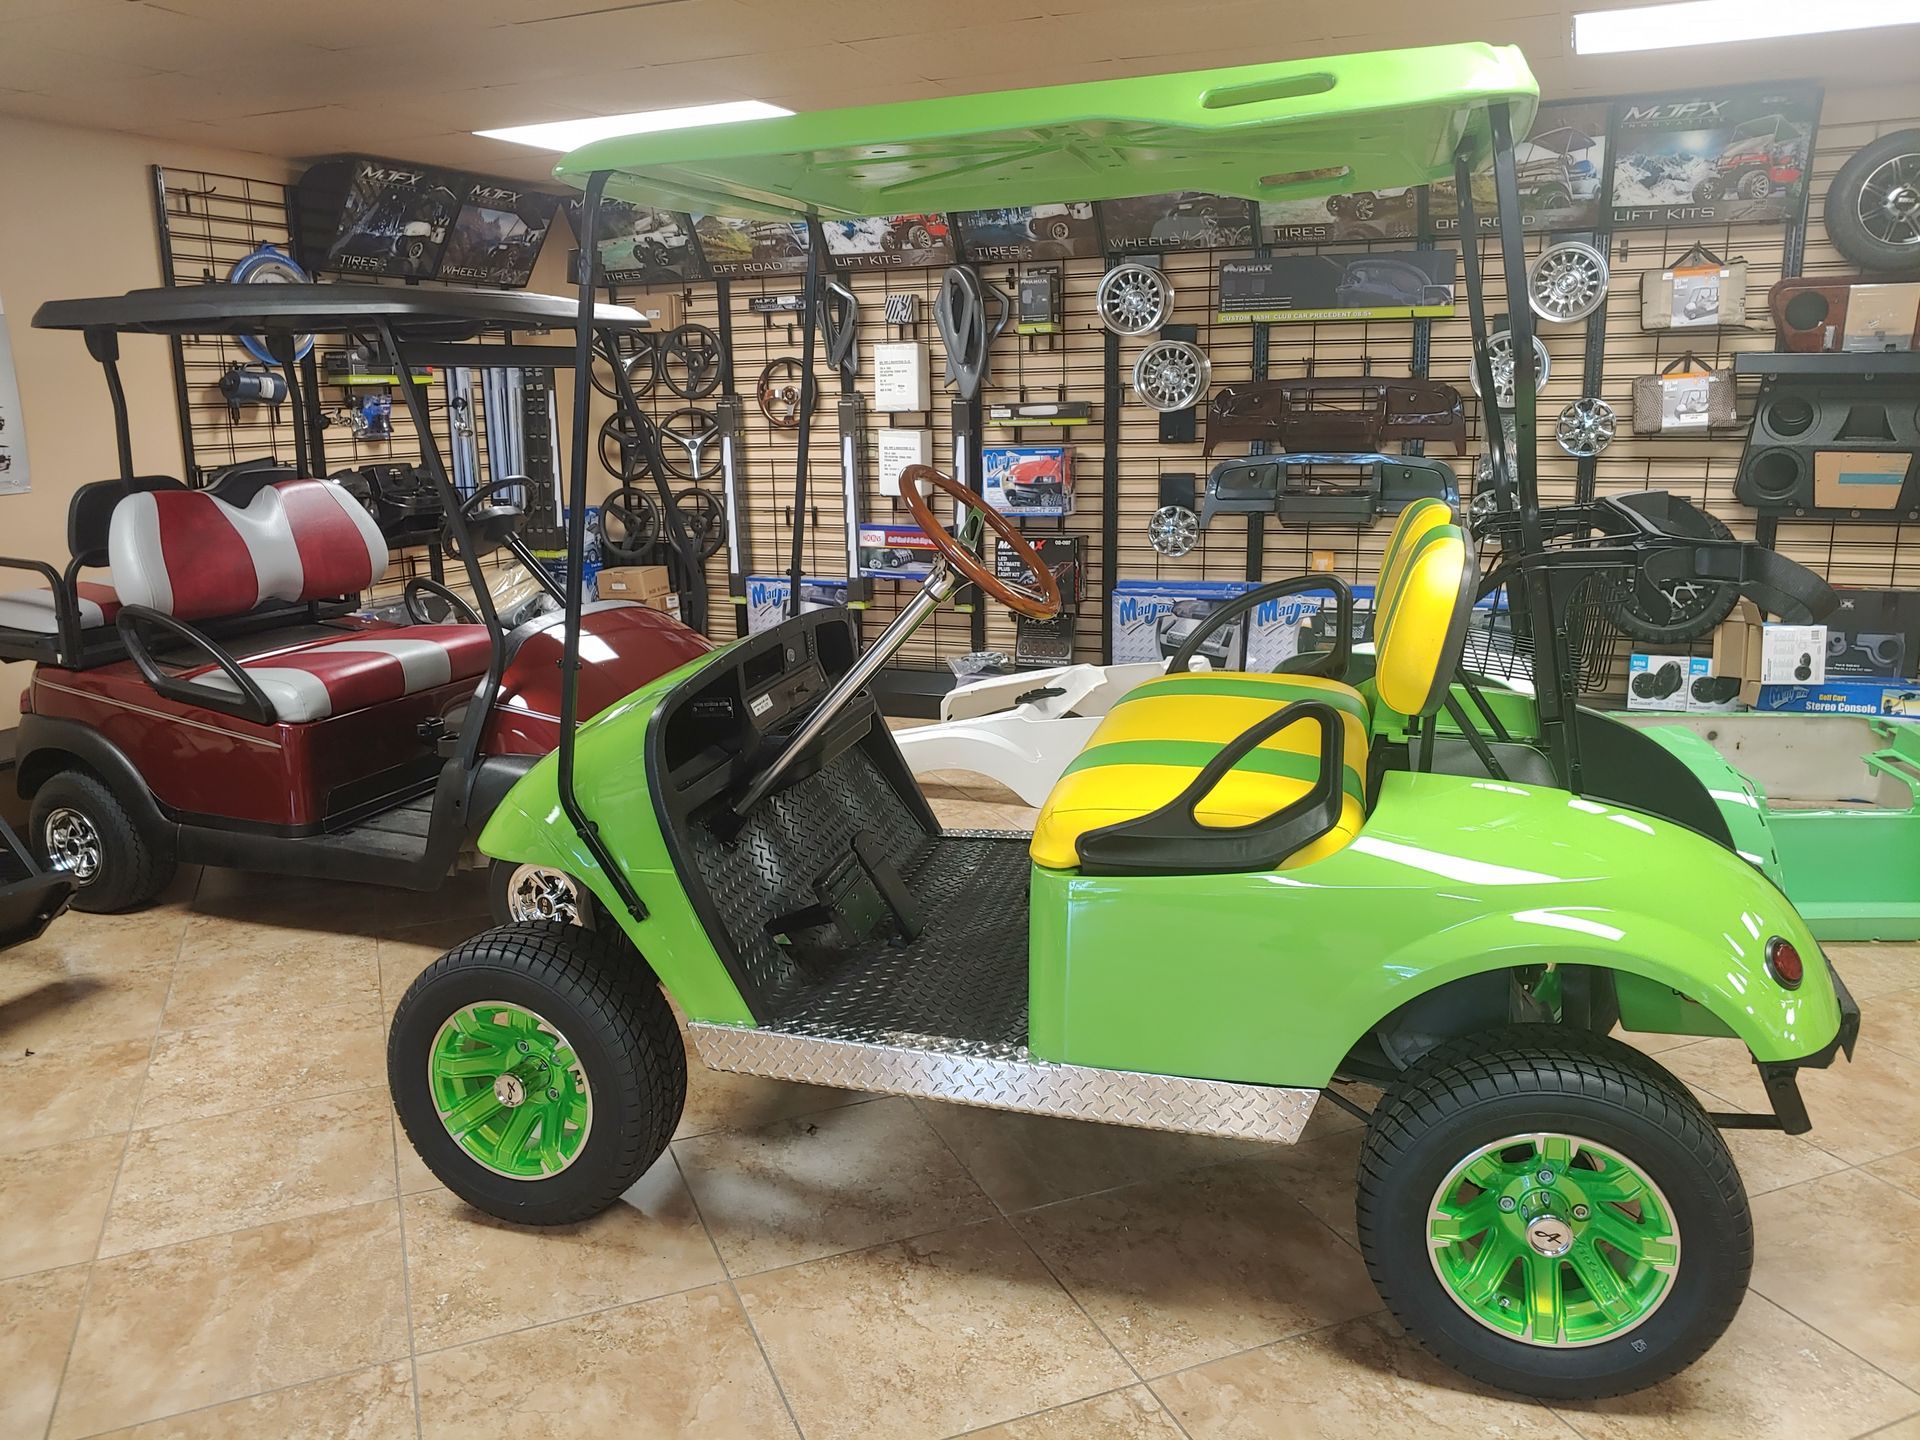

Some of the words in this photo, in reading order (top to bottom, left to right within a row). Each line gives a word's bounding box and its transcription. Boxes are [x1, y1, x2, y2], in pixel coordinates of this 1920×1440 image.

[1614, 209, 1659, 222] LIFT
[1667, 207, 1715, 220] KITS
[1435, 217, 1460, 230] OF
[1479, 215, 1536, 229] ROD
[1273, 226, 1326, 238] TIRES
[1109, 236, 1181, 249] WHEELS
[974, 245, 1020, 257] TIRES
[340, 254, 379, 268] TIRES
[712, 263, 739, 273] OFF
[742, 261, 783, 273] ROAD
[834, 256, 864, 267] LIFT
[869, 254, 902, 265] KITS
[441, 265, 488, 278] WHEELS
[604, 271, 641, 282] TIRES
[751, 583, 790, 609] MadJa
[1119, 597, 1173, 627] MadJax
[1257, 598, 1318, 628] MadJax
[1805, 701, 1837, 712] Stereo
[1838, 702, 1877, 714] Console
